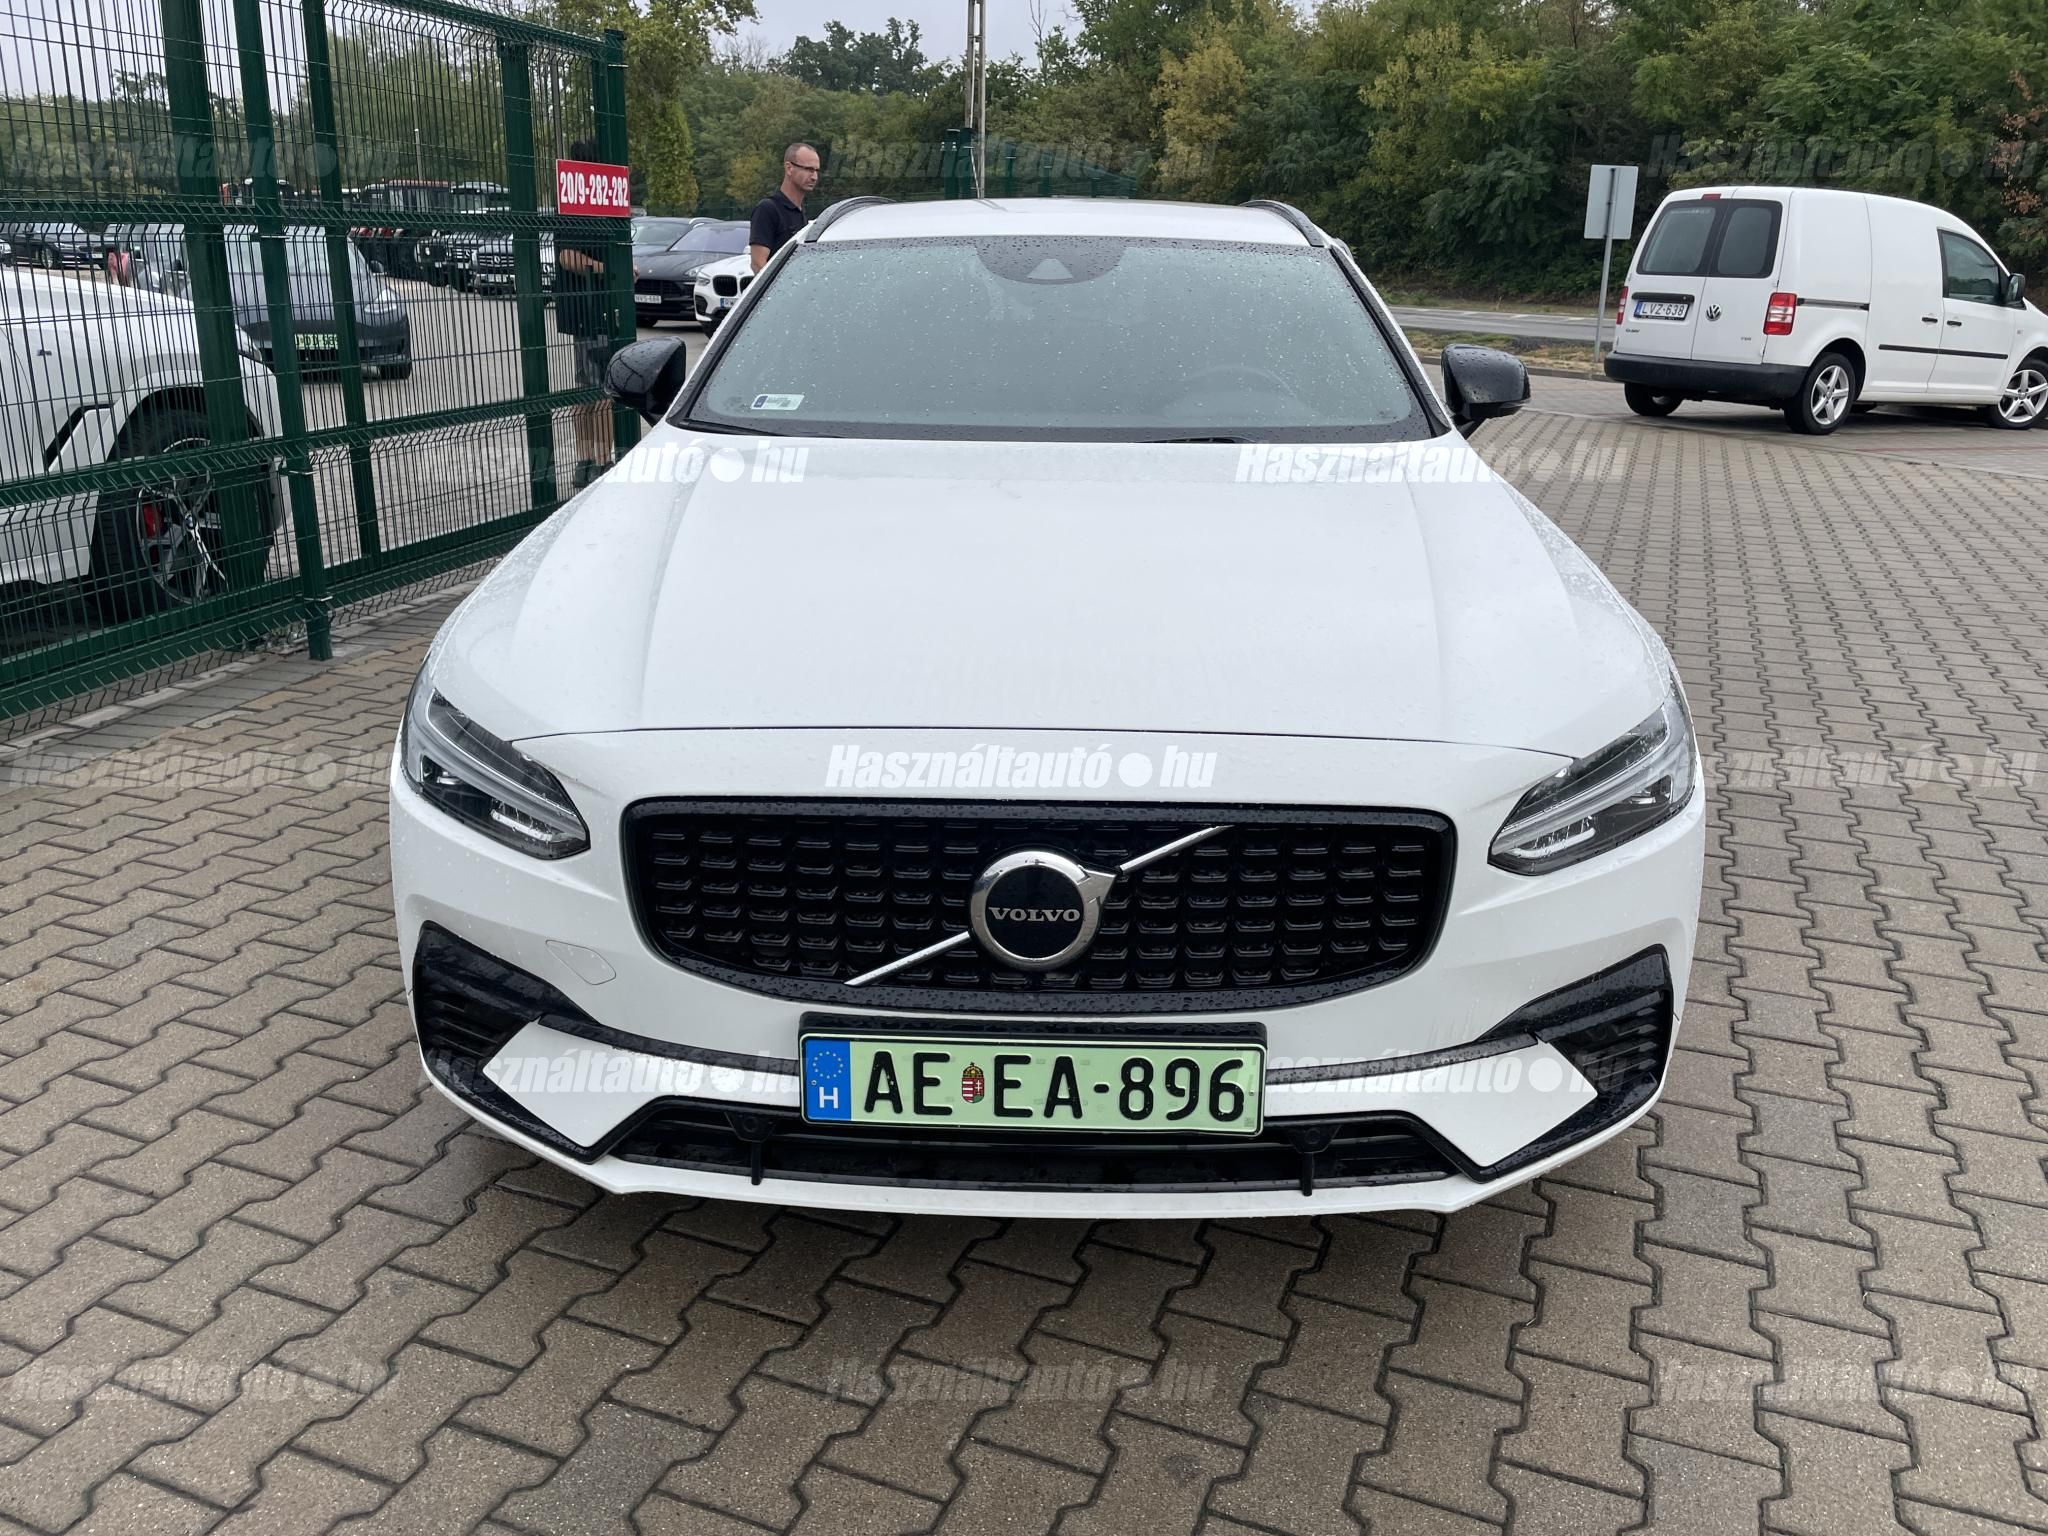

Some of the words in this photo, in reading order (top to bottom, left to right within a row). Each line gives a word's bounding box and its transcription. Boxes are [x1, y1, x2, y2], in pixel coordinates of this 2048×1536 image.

[559, 171, 629, 208] 20/9-282-282
[1641, 303, 1685, 316] LVZ-638
[988, 906, 1081, 922] VOLVO
[818, 1086, 840, 1109] H
[863, 1050, 953, 1115] AE
[993, 1054, 1245, 1122] EA-896
